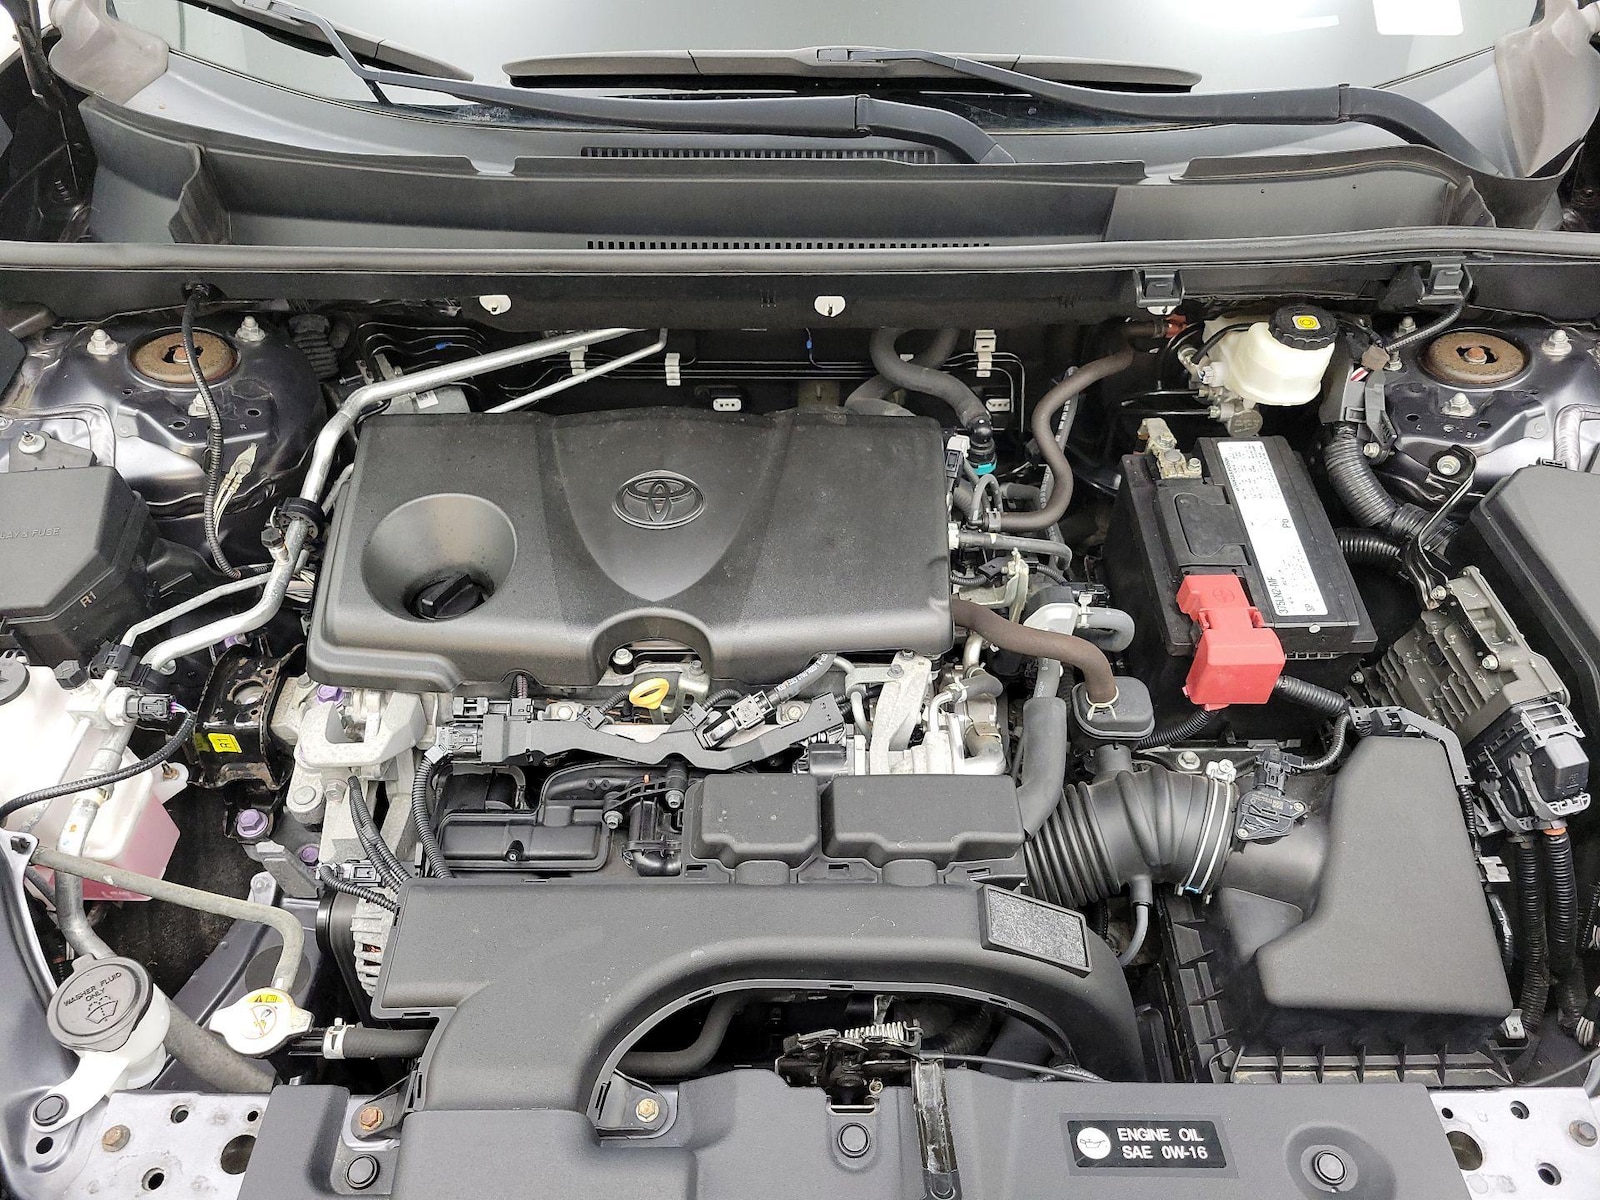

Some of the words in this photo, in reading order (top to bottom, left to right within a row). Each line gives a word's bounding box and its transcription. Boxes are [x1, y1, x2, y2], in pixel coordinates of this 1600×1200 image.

[32, 527, 60, 537] FUSE
[80, 590, 97, 608] R1
[64, 985, 96, 1006] WASHER
[100, 972, 122, 986] FLUID
[86, 988, 105, 1001] ONLY
[1117, 1127, 1171, 1142] ENGINE
[1178, 1128, 1204, 1142] OIL
[1122, 1145, 1153, 1160] SAE
[1161, 1145, 1208, 1160] 0W-16
